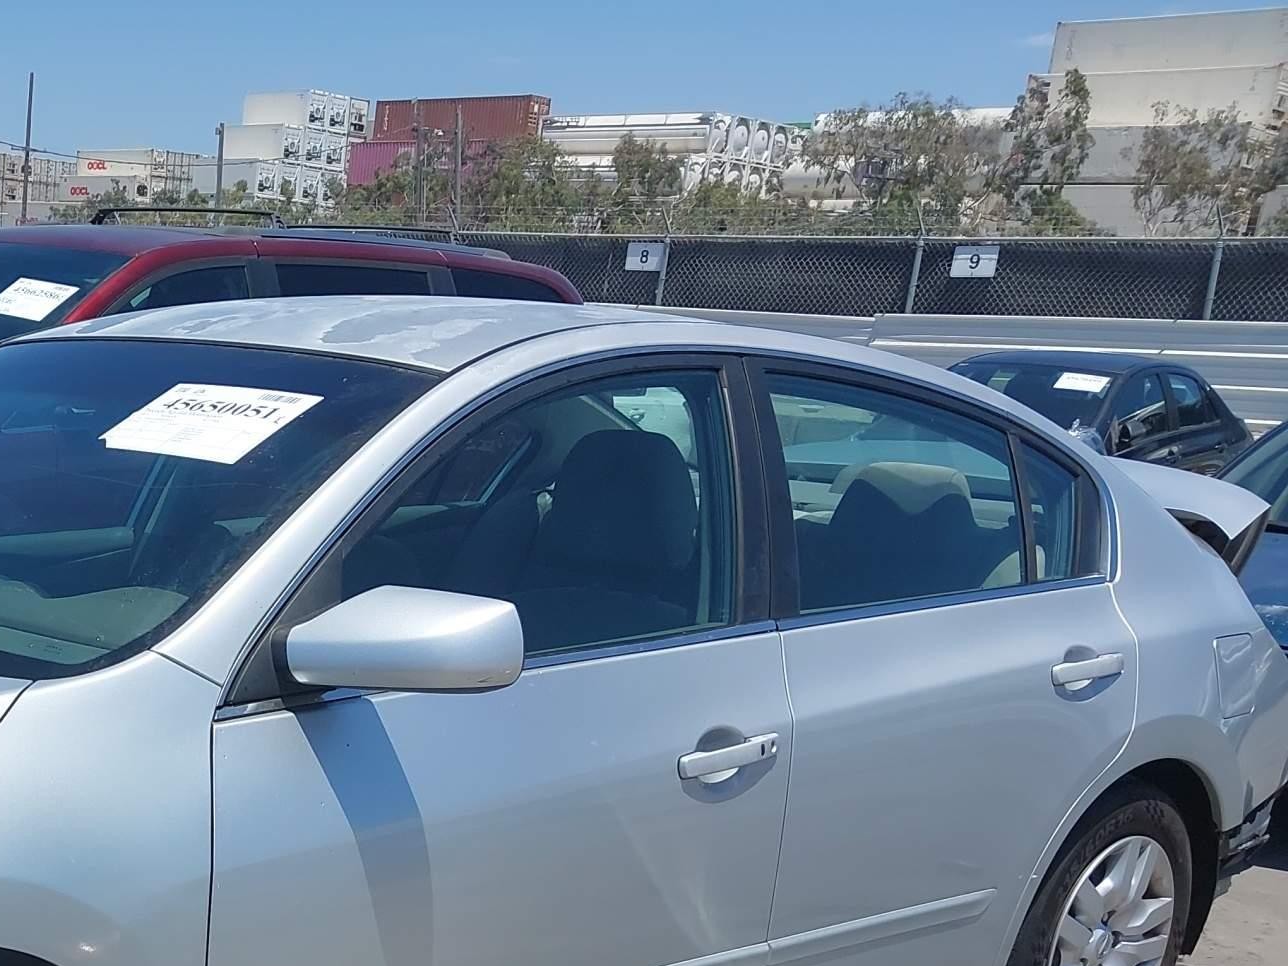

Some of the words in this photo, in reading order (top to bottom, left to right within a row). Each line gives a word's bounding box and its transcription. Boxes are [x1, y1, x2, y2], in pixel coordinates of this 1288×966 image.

[87, 161, 107, 170] OOCL
[70, 187, 90, 196] OOCL
[639, 249, 649, 264] 8
[968, 253, 981, 269] 9
[163, 398, 281, 420] 45650051
